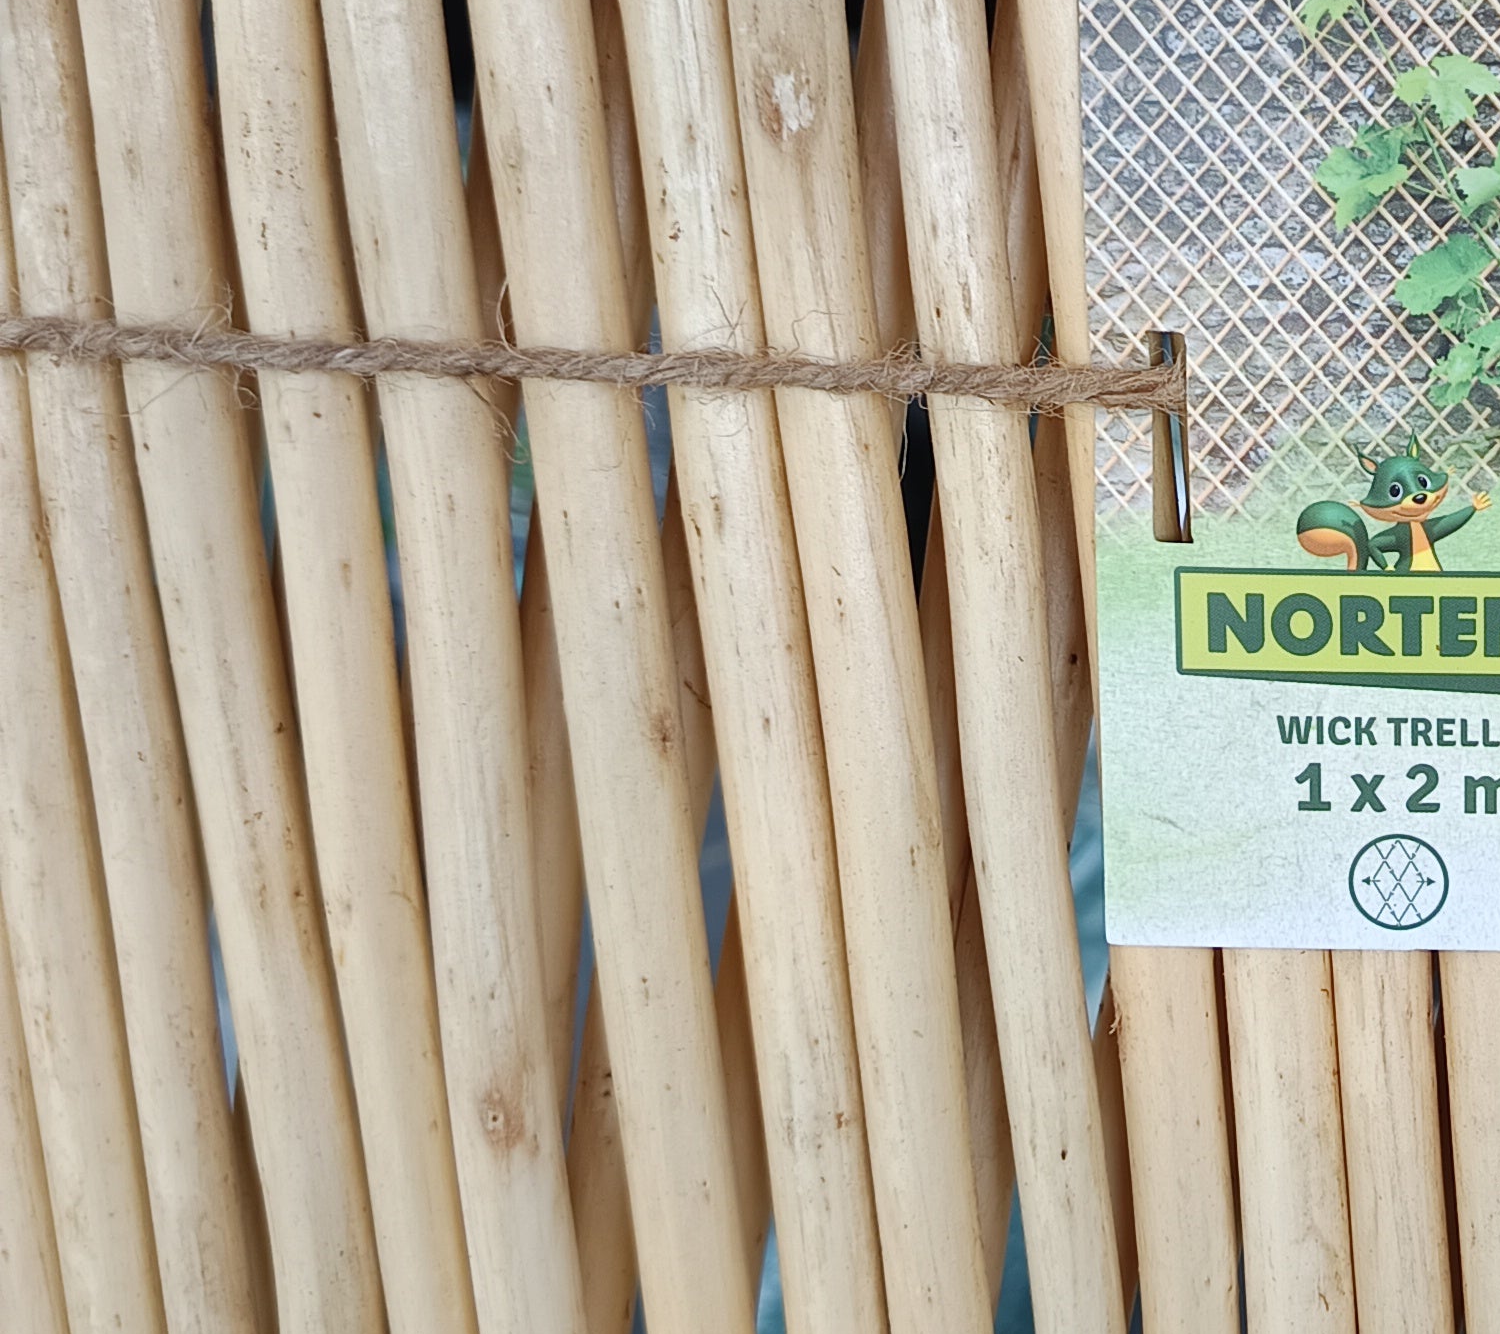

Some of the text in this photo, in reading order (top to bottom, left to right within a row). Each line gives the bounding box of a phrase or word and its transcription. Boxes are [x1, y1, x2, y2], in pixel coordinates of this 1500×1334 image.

[1276, 715, 1378, 746] WICK
[1294, 762, 1332, 812] 1
[1350, 773, 1387, 813] x
[1405, 763, 1441, 813] 2
